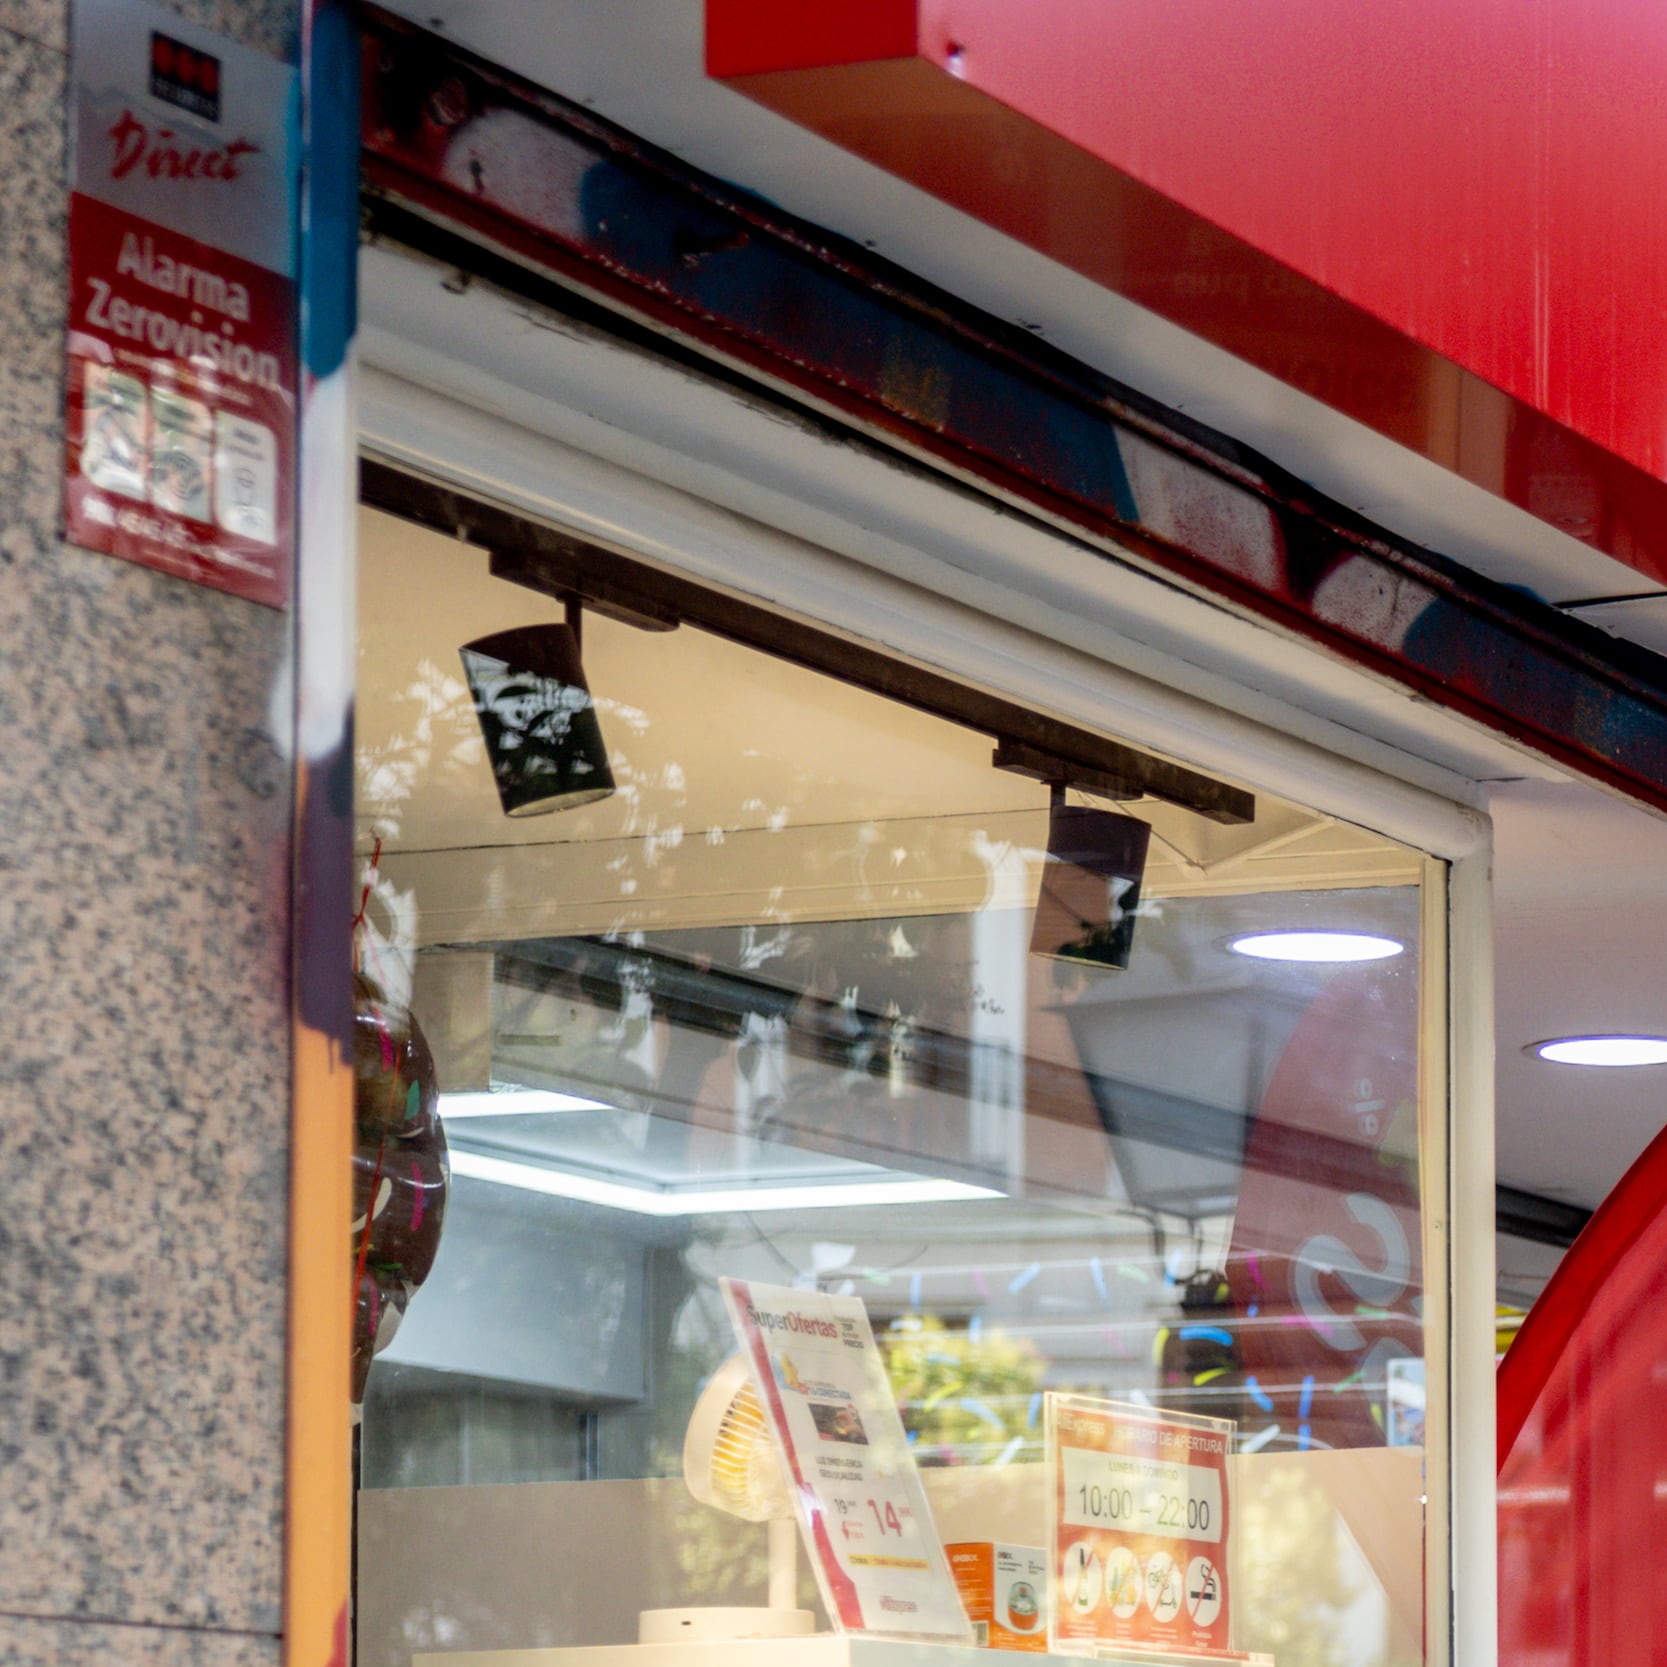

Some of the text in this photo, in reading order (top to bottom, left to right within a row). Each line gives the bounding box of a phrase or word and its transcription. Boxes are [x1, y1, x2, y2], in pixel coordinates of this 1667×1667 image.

[107, 110, 263, 181] Direct
[117, 232, 250, 322] Alarma
[85, 276, 281, 387] Zerovision
[746, 1304, 838, 1339] SuperOfertas
[1159, 1431, 1173, 1445] DE
[1174, 1433, 1223, 1455] APERTURA
[867, 1499, 903, 1537] 14
[1080, 1484, 1132, 1520] 10:00
[1157, 1494, 1210, 1532] 22:00
